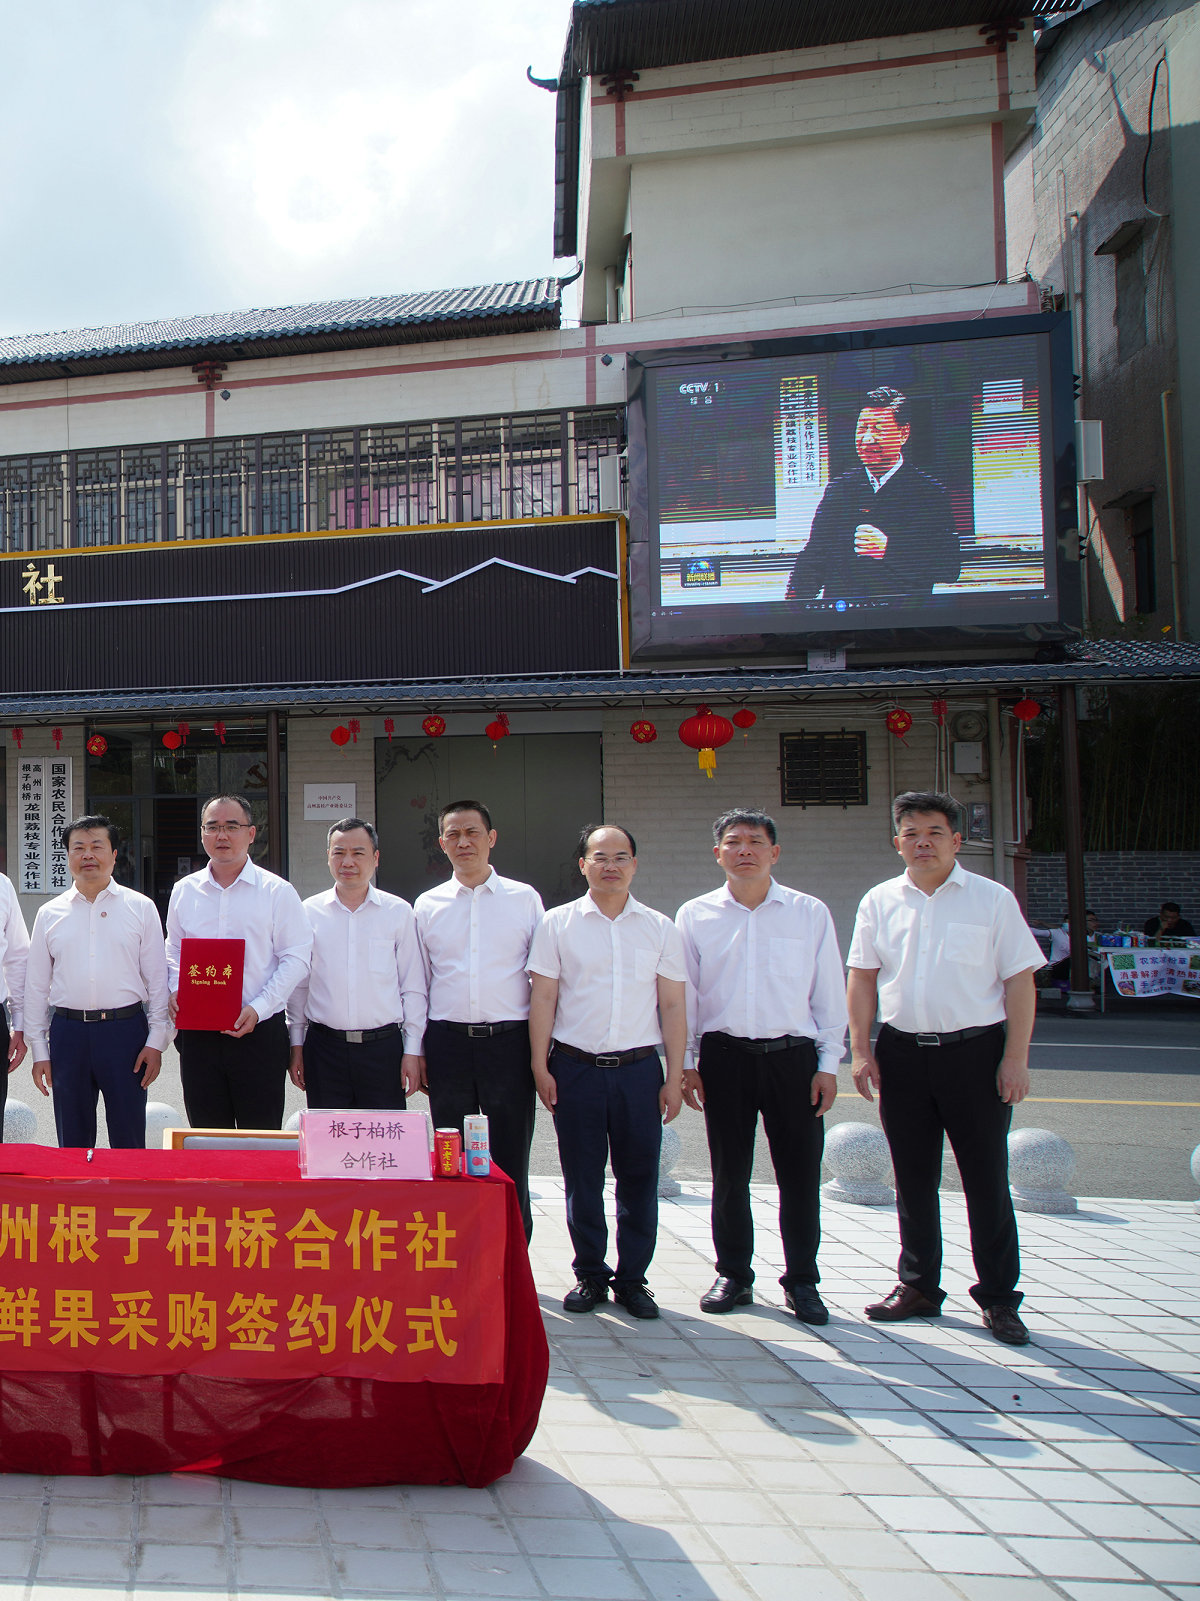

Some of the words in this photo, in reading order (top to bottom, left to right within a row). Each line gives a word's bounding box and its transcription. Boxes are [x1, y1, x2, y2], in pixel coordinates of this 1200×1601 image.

[51, 763, 66, 888] 国家农民合作社示范社
[24, 803, 41, 890] 龙眼荔枝专业合作社
[328, 1120, 406, 1141] 根子柏桥
[341, 1151, 398, 1171] 合作社
[442, 1141, 452, 1172] 王老吉
